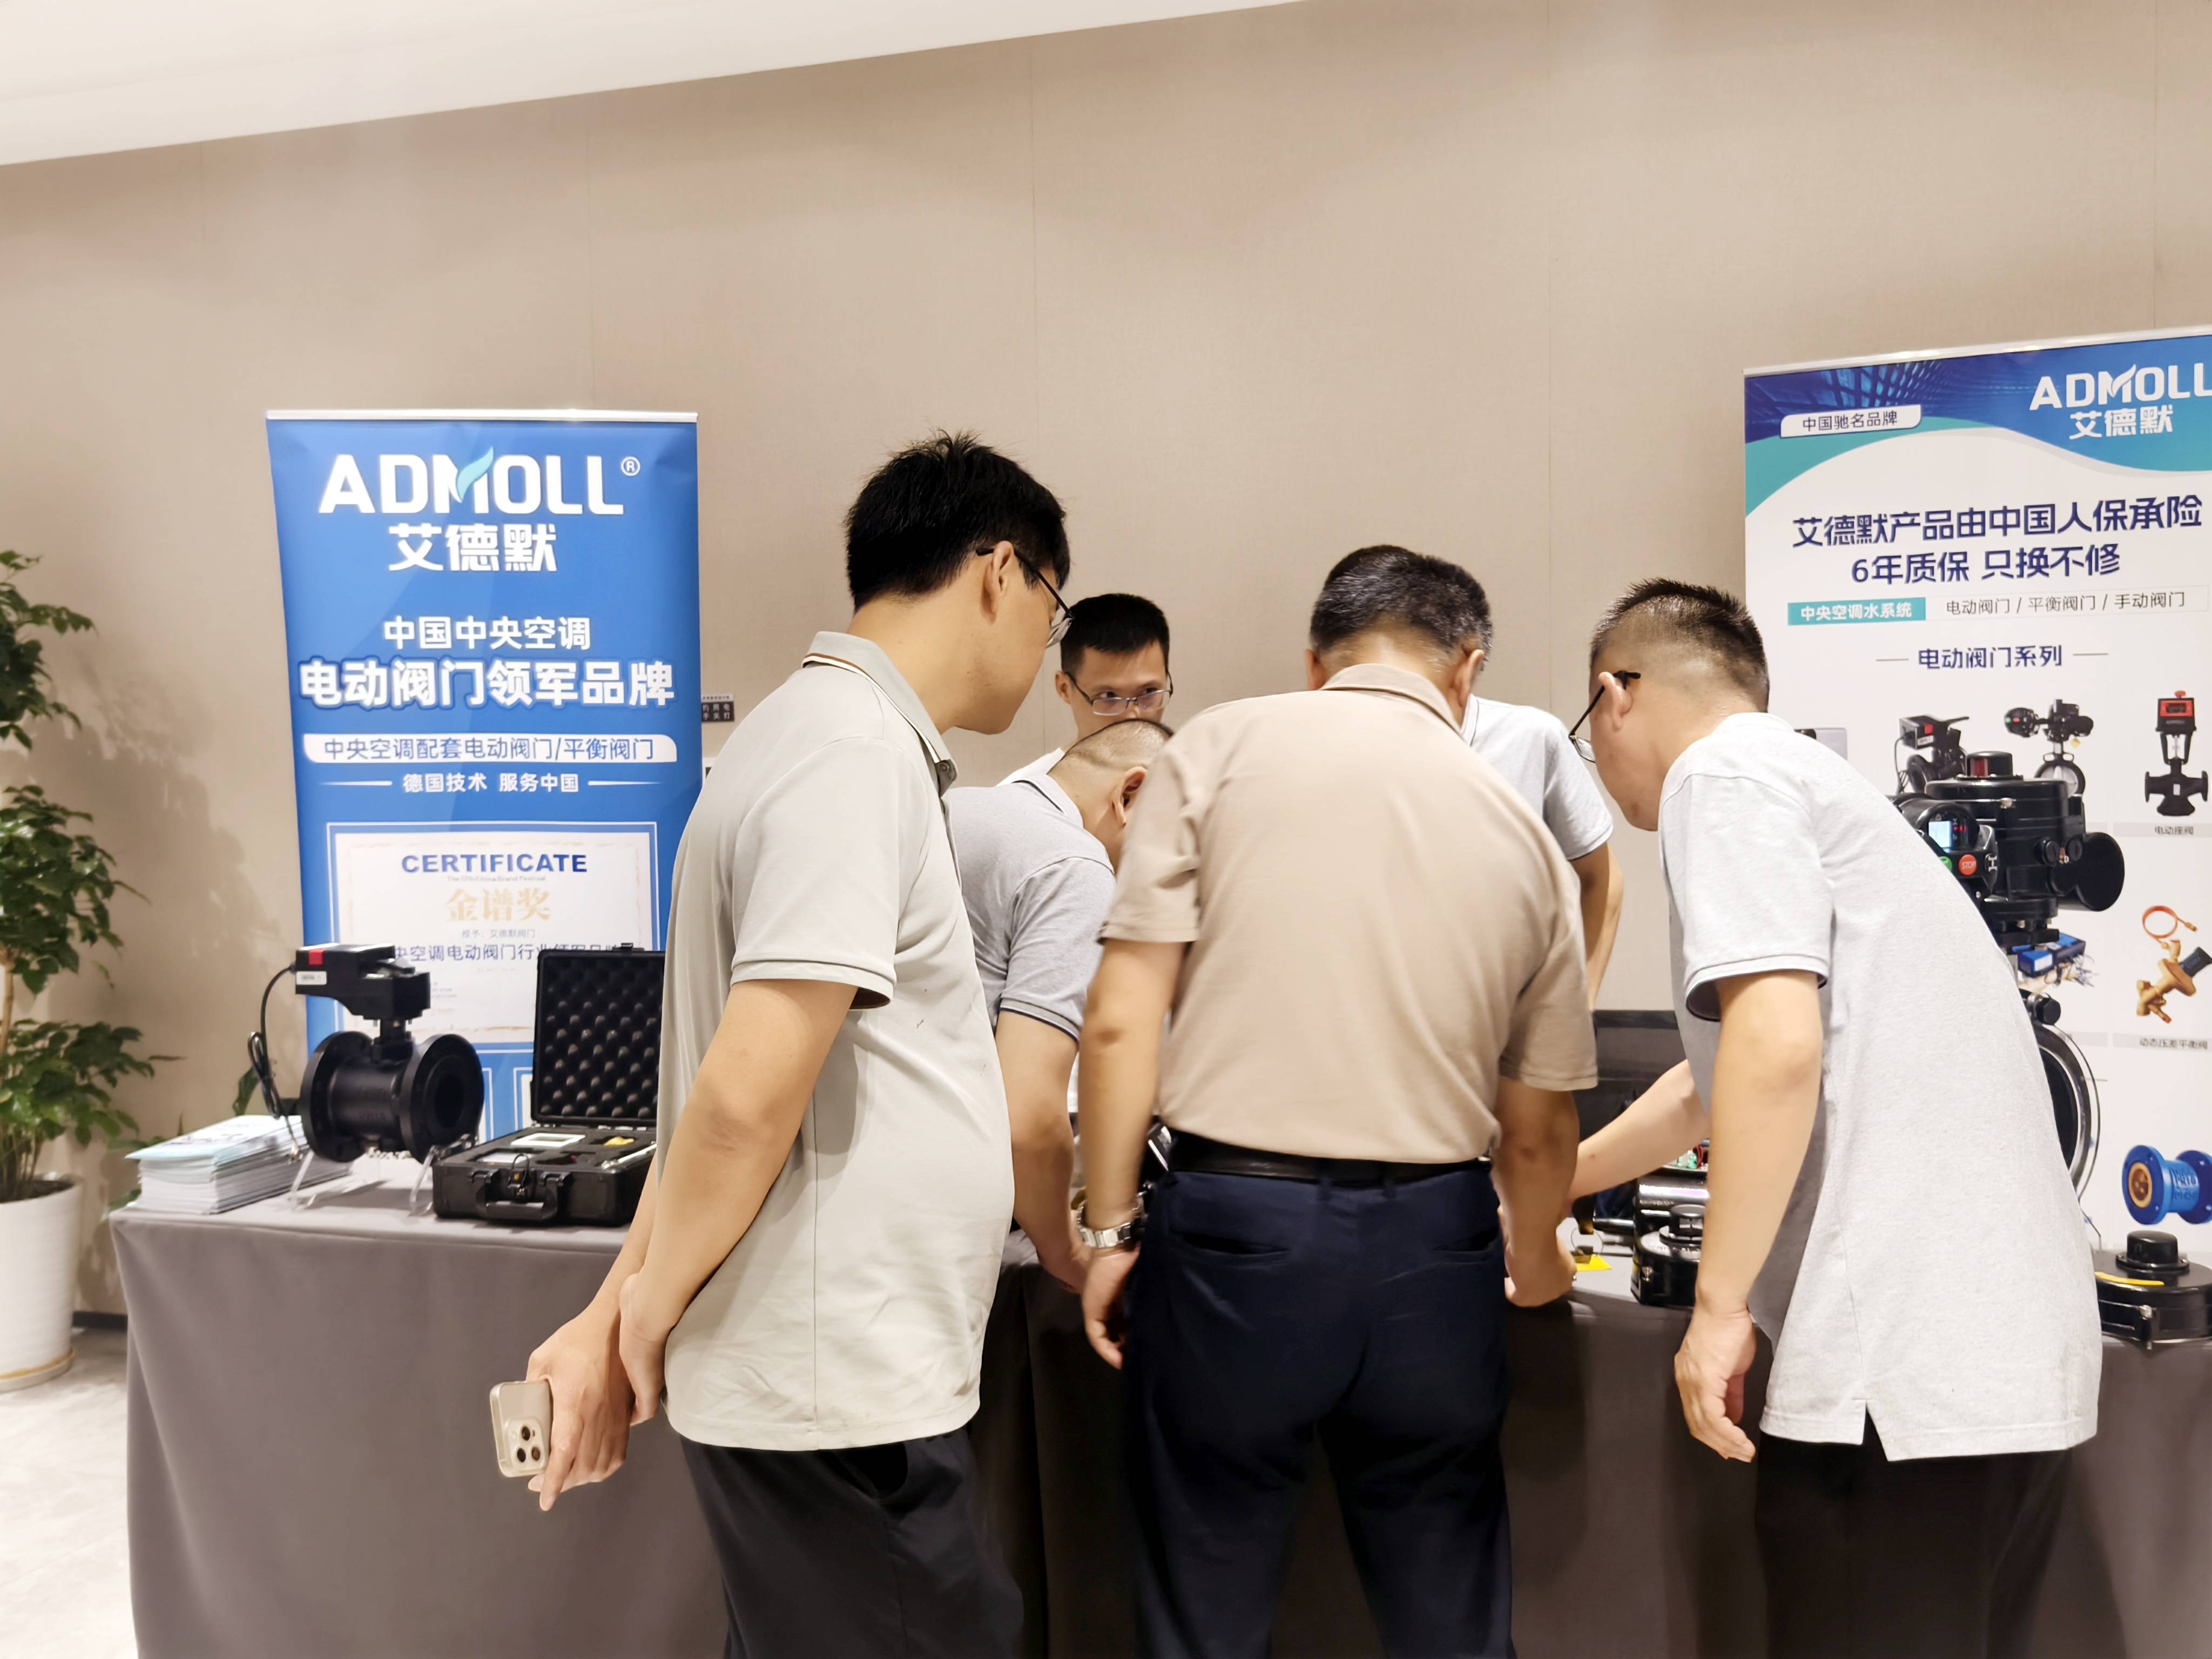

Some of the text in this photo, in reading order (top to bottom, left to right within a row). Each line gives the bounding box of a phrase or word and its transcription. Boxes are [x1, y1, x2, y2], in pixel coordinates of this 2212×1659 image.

[2029, 362, 2212, 410] ADMOLL
[1802, 410, 1898, 433] 中国驰名品牌
[2069, 404, 2174, 440] 艾德默
[318, 447, 624, 515] ADMOLL
[1791, 494, 2202, 549] 艾德默产品由中国人保承险
[388, 522, 557, 571] 艾德默
[1851, 543, 2120, 585] 6年质保 只换不修
[1800, 602, 1912, 622] 中央空调水系统
[1946, 598, 2011, 616] 电动阀门
[2027, 595, 2096, 613] 平衡阀门
[2113, 591, 2185, 610] 手动阀门
[383, 615, 591, 650] 中国中央空调
[1918, 645, 2063, 670] 电动阀门系列
[299, 659, 675, 706] 电动阀门领军品牌
[323, 737, 654, 761] 中央空调配套电动阀门/平衡阀门
[402, 772, 579, 793] 德国技术 服务中国
[401, 853, 588, 873] CERTIFICATE
[444, 887, 552, 922] 金谱奖
